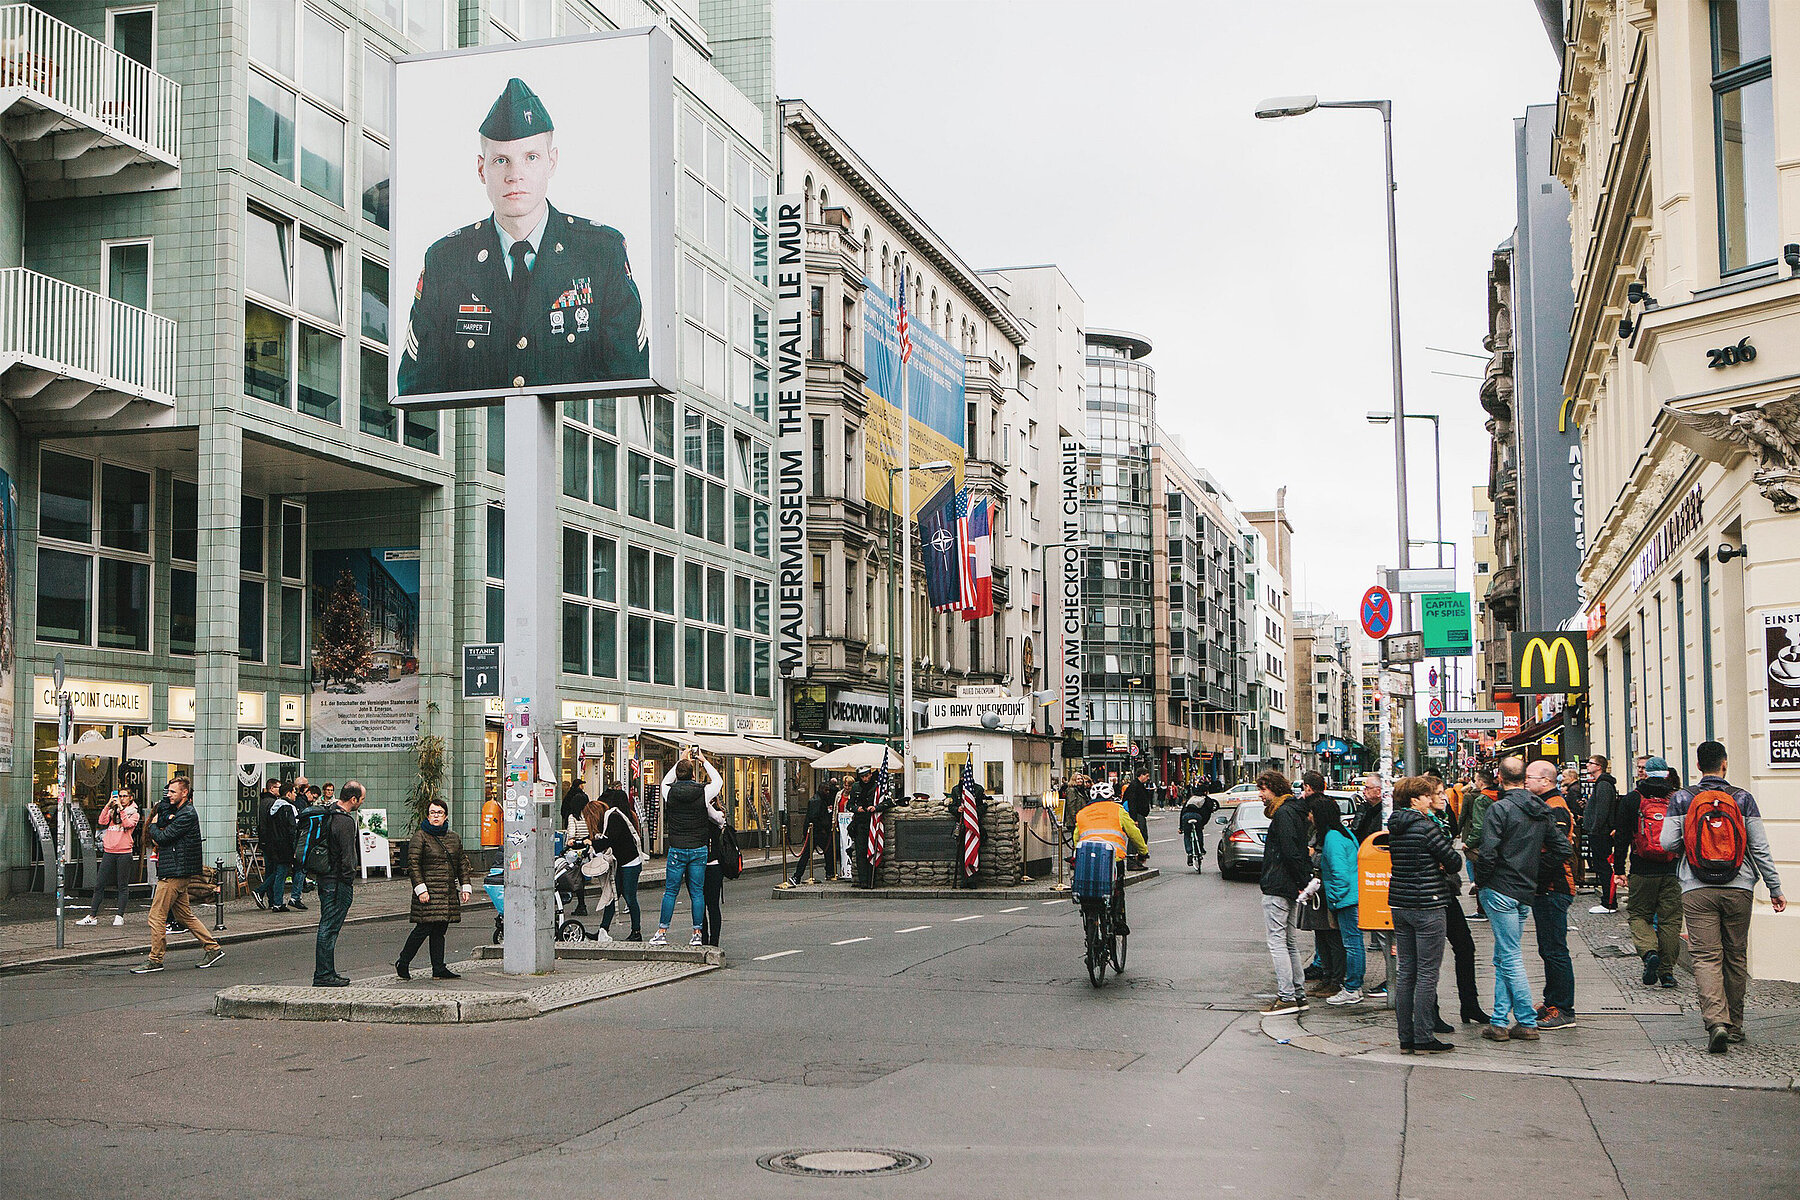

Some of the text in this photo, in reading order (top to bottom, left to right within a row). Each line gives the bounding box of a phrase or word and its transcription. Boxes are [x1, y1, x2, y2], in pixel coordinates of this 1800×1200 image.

[463, 323, 484, 332] HARPER
[1706, 336, 1757, 368] 206
[778, 203, 803, 667] MAUERMUSEUM THE WALL LE MUR
[1063, 441, 1080, 721] HAUS AM CHECKPONT CHARLIE
[1426, 600, 1464, 609] CAPITAL
[1440, 609, 1466, 618] SPIES
[962, 686, 996, 695] ALLIED CHECKPOINT
[43, 689, 139, 710] CHKPOINT CHARLIE
[832, 701, 872, 724] CHECKPOINT
[950, 704, 972, 716] ARMY
[1327, 740, 1336, 748] U
[1375, 879, 1389, 887] dirty
